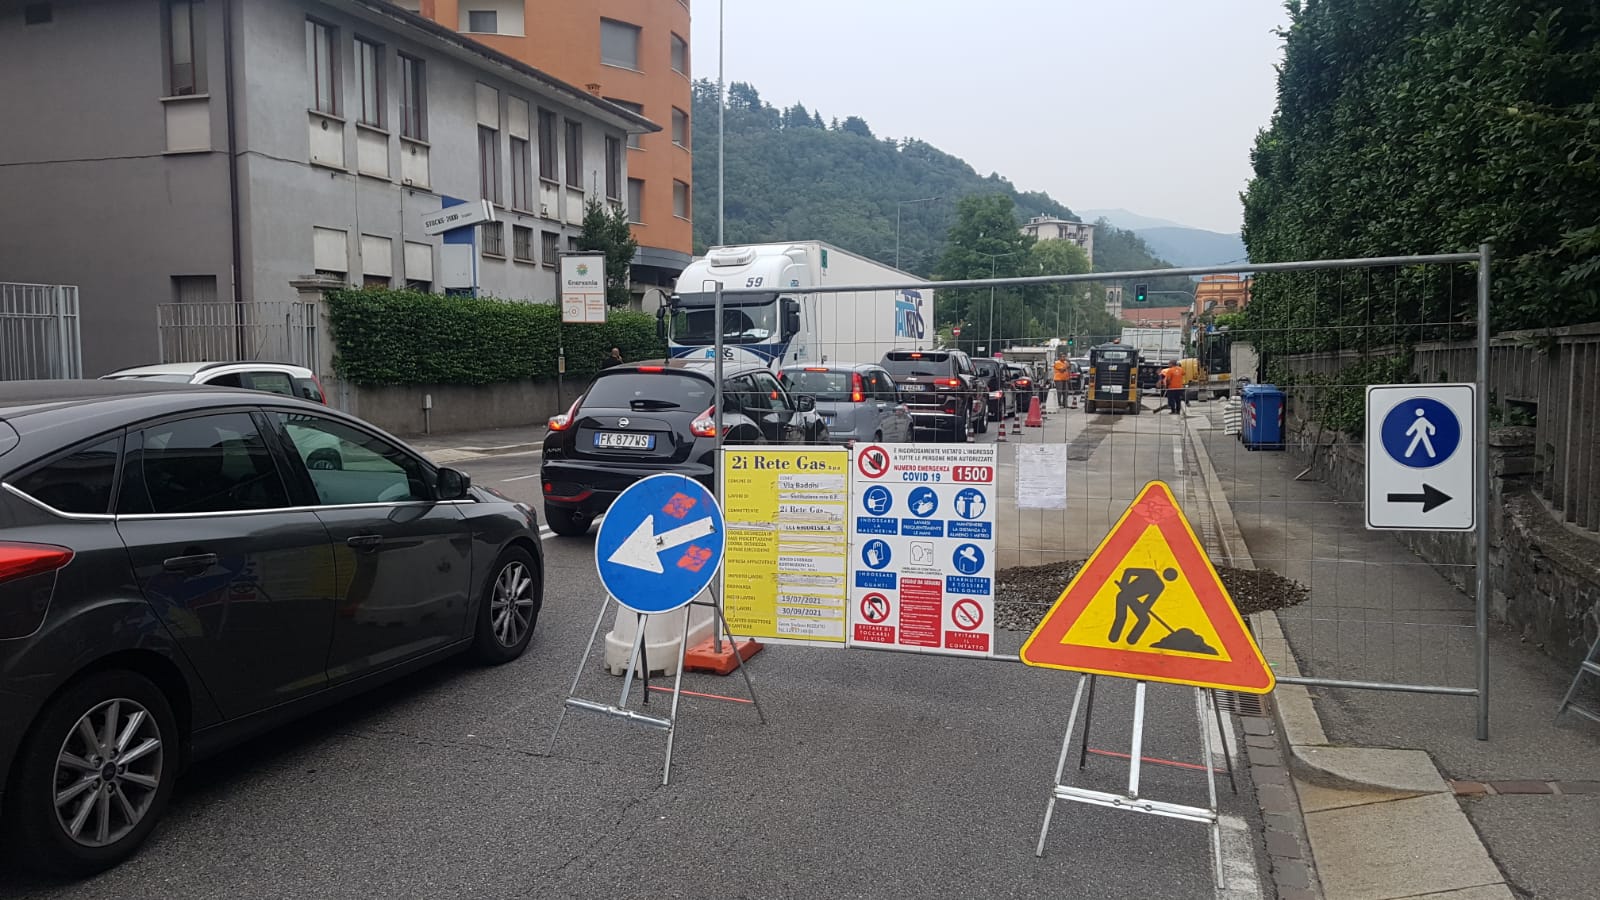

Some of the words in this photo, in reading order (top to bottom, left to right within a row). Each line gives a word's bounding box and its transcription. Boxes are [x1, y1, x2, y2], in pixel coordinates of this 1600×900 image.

[745, 277, 764, 287] 59
[600, 434, 613, 445] FK
[616, 434, 648, 446] 877WS
[731, 455, 748, 470] 2i
[754, 455, 791, 470] Rete
[796, 455, 826, 471] Gas
[902, 472, 929, 481] COVID
[931, 472, 941, 482] 19
[957, 467, 988, 480] 1500
[781, 595, 821, 604] 19/07/2021
[781, 607, 822, 616] 30/09/2021
